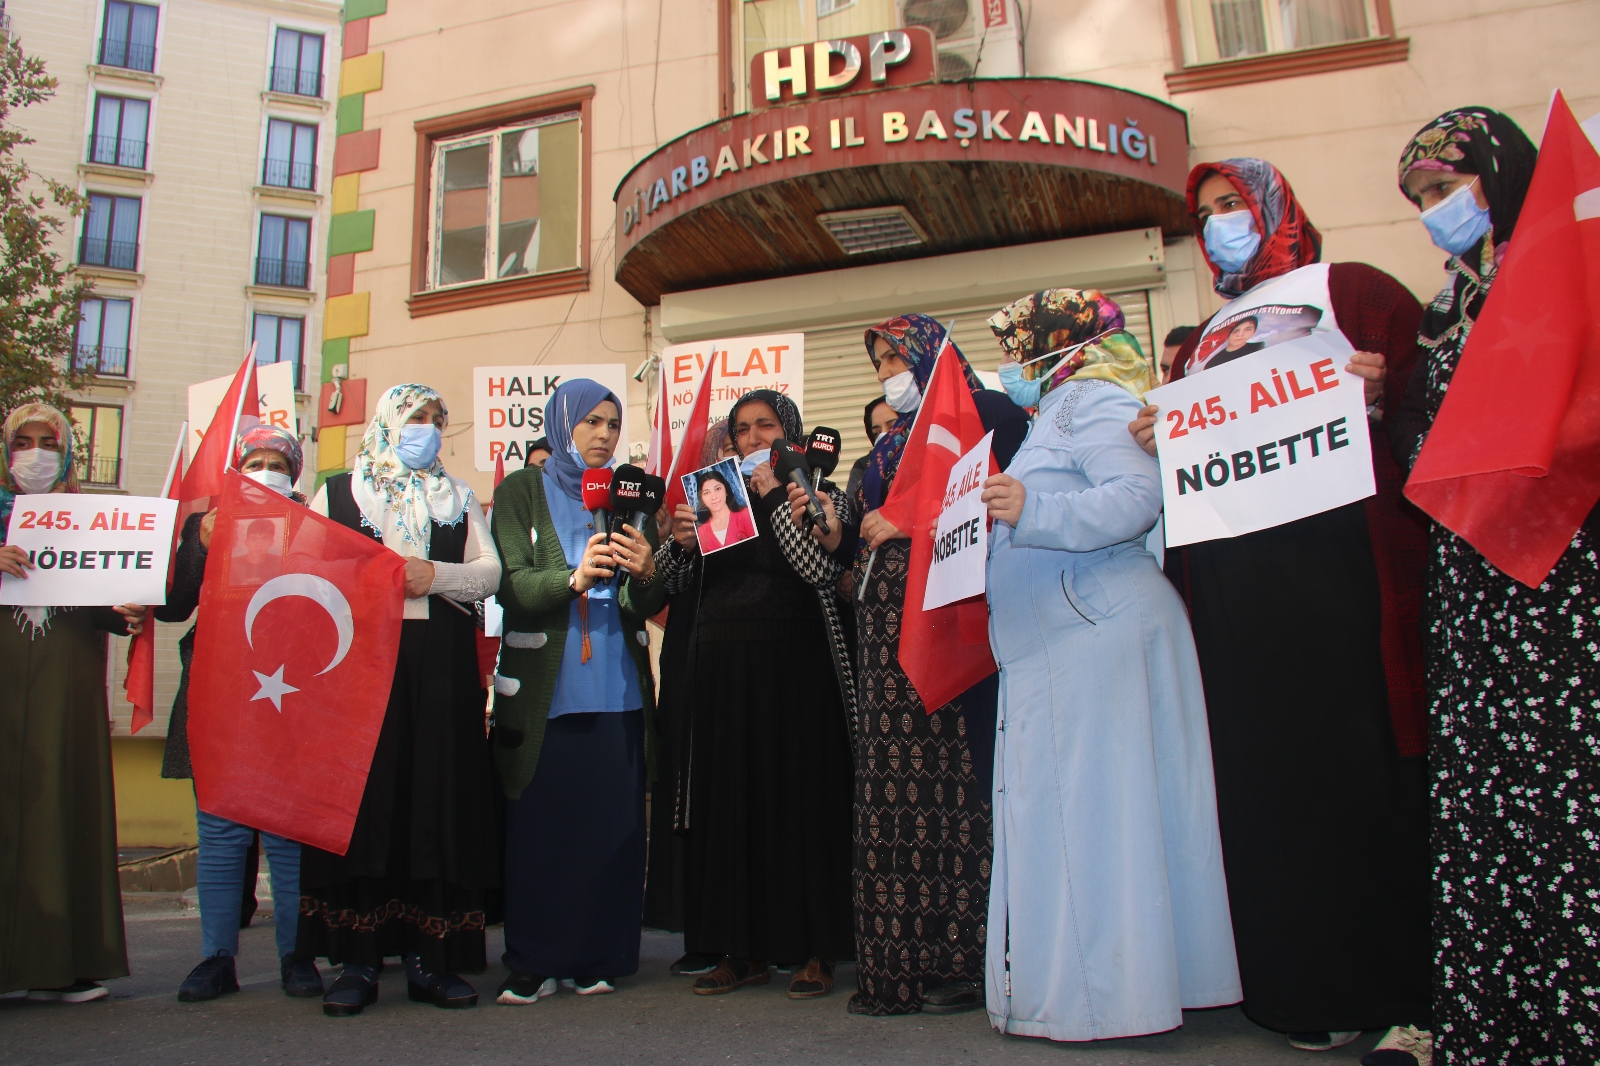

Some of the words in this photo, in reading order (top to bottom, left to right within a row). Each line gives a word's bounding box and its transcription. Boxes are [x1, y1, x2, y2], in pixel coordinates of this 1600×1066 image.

[764, 31, 912, 101] HDP
[623, 125, 812, 236] DİYARBAKIR
[882, 108, 1158, 164] BAŞKANLIĞI
[673, 345, 789, 384] EVLAT
[488, 375, 562, 397] HALK
[1166, 395, 1238, 440] 245.
[1250, 358, 1340, 414] AİLE
[488, 403, 544, 432] DÜŞ
[815, 433, 835, 443] TRT
[1175, 416, 1349, 496] NÖBETTE
[617, 490, 641, 498] HABER
[619, 480, 642, 492] TRT
[957, 460, 983, 501] AİLE
[18, 510, 80, 530] 245.
[90, 508, 157, 531] AİLE
[933, 516, 980, 566] NÖBETTE
